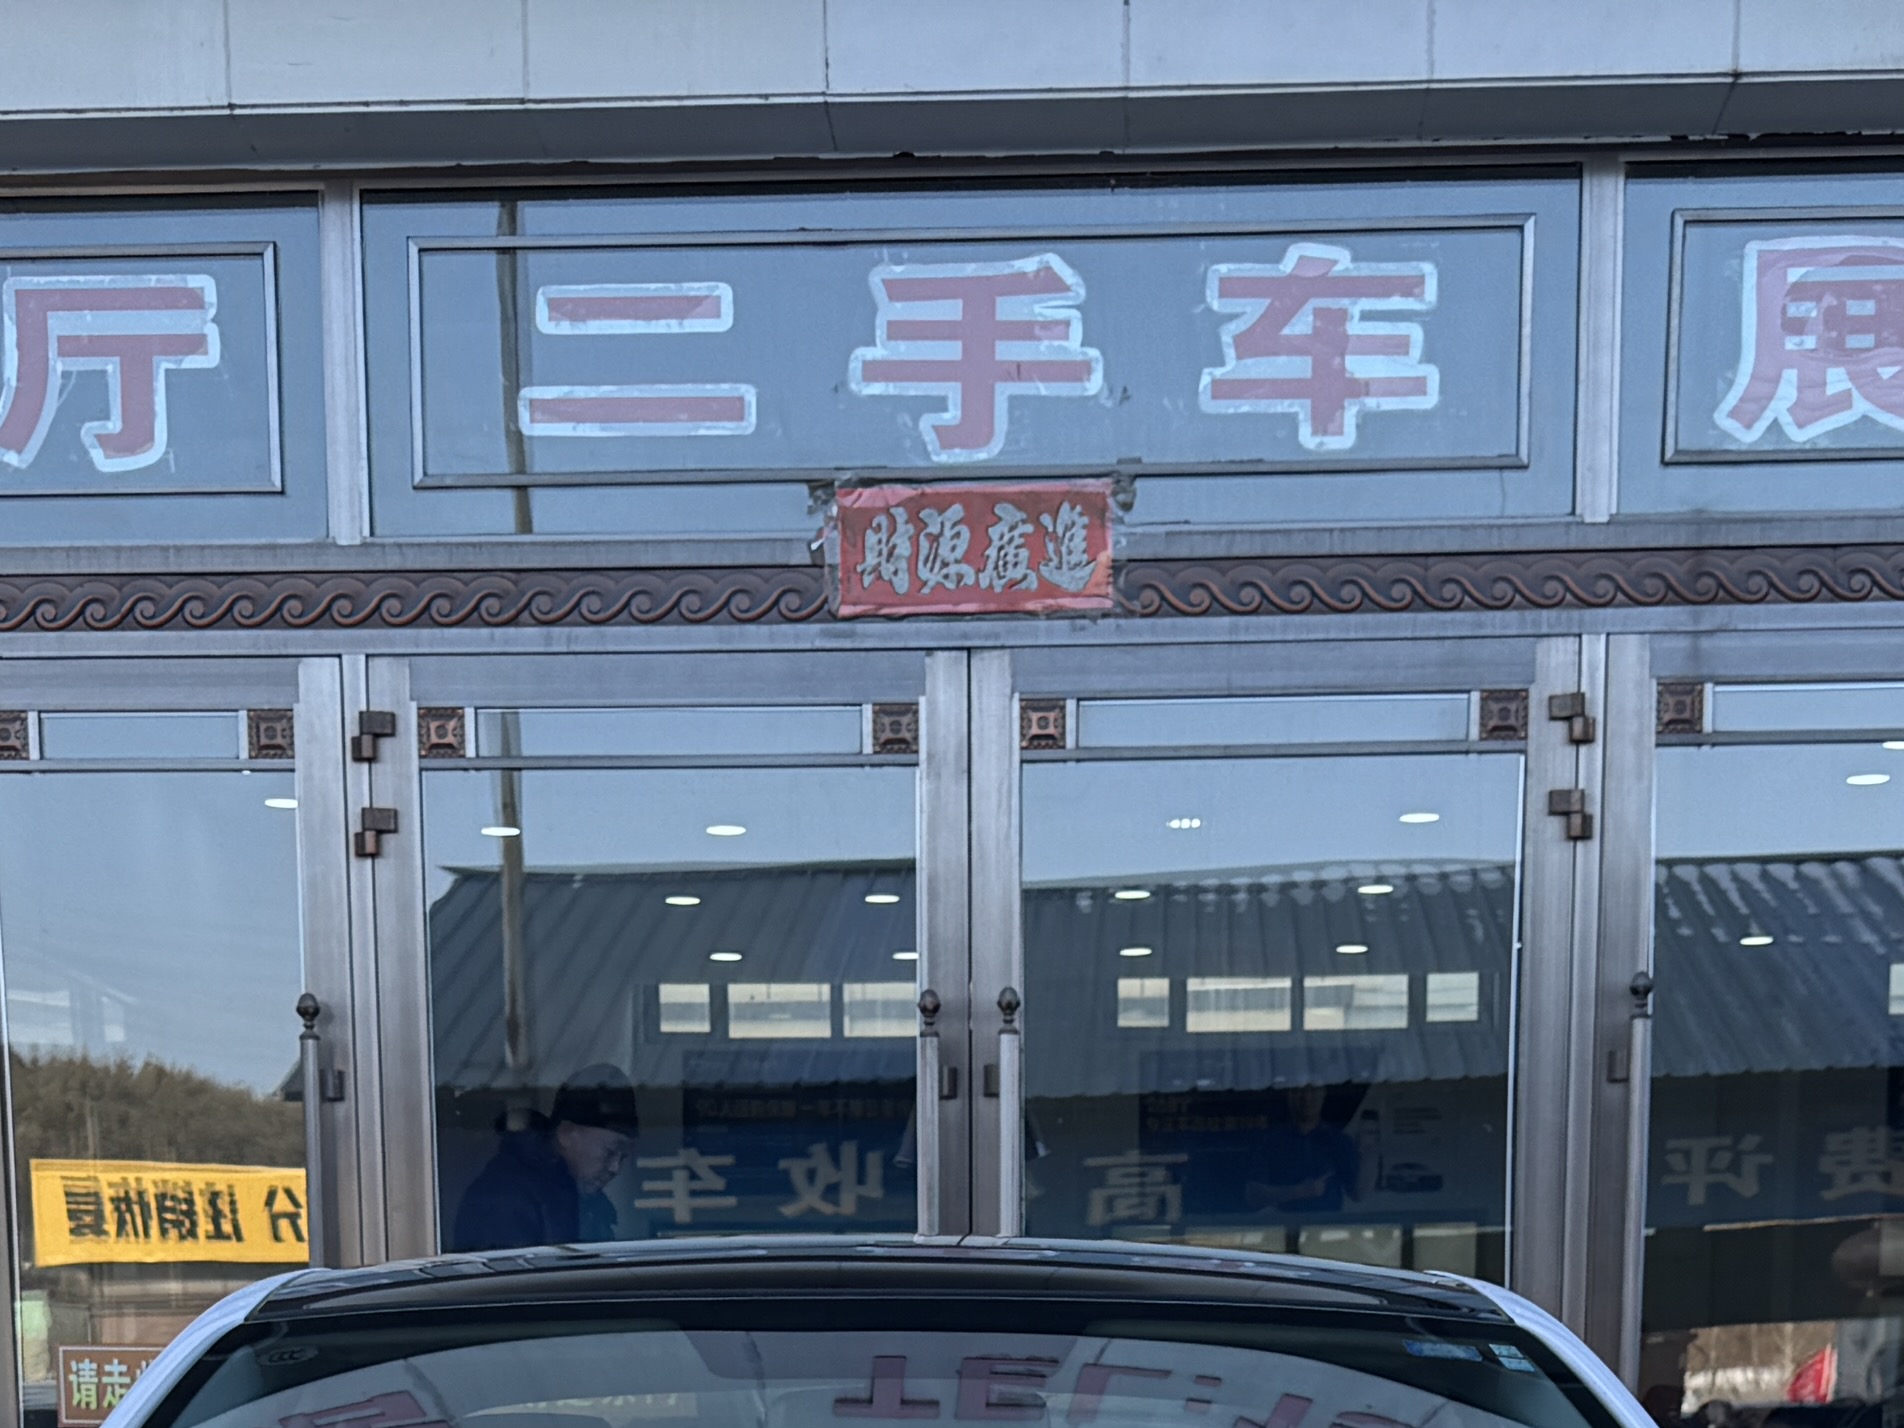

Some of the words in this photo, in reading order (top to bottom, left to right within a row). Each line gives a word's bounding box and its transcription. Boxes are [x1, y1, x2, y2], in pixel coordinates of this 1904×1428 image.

[518, 243, 1441, 461] 二手车
[68, 1358, 154, 1410] 请走
